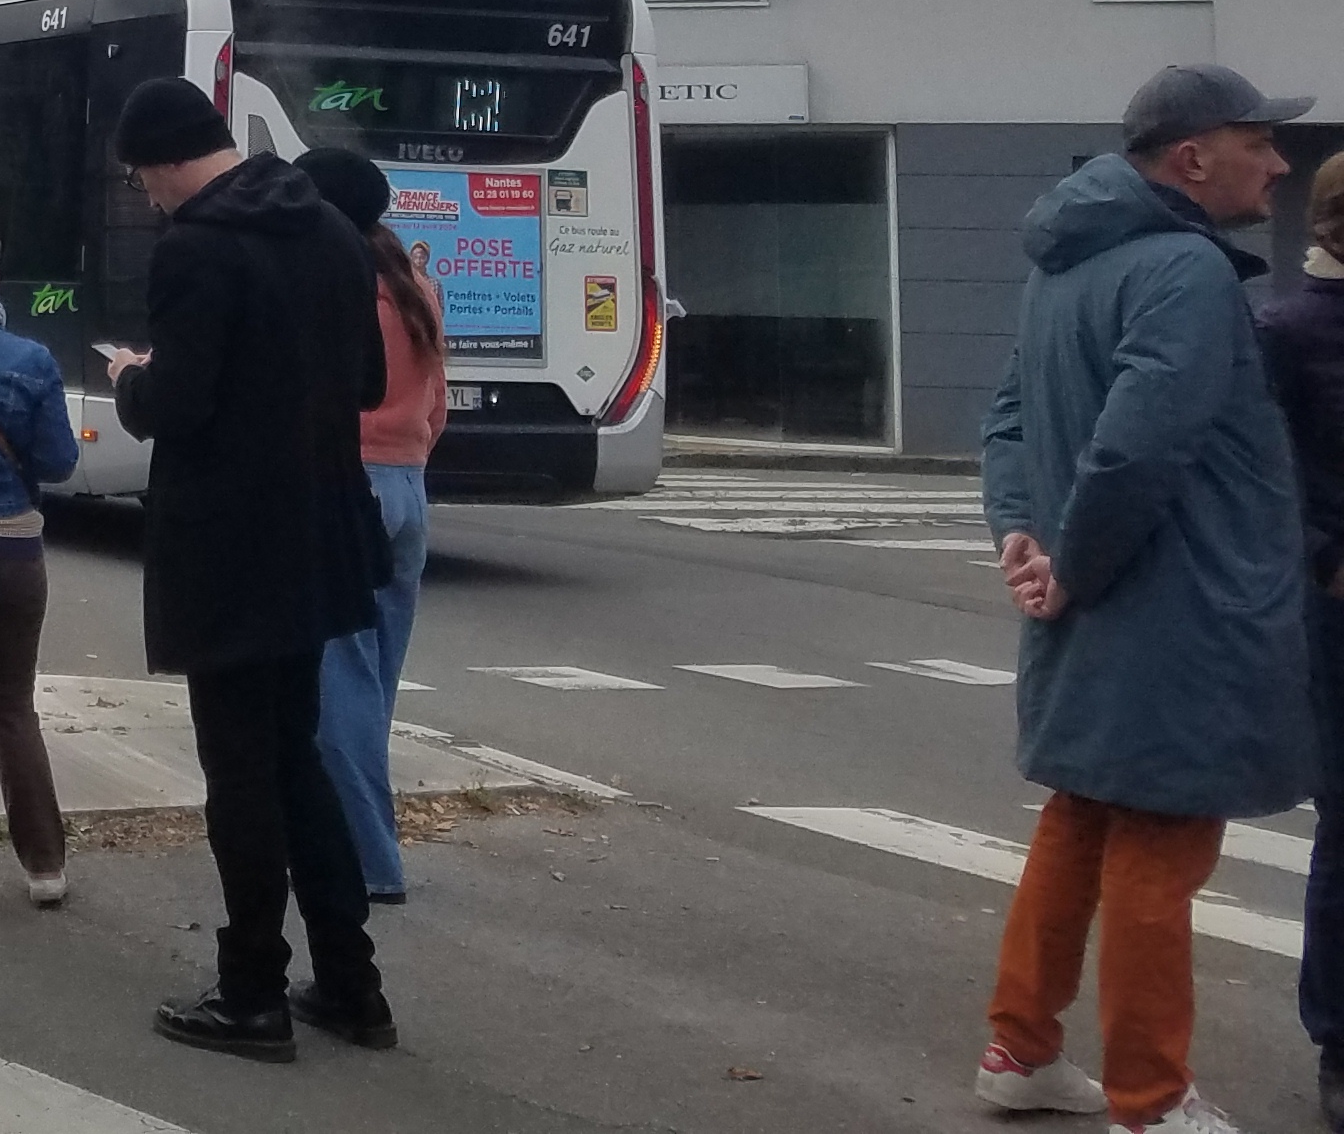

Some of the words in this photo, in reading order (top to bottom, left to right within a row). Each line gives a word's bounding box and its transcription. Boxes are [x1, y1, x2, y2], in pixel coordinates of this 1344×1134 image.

[41, 7, 68, 32] 641
[547, 24, 592, 48] 641
[309, 80, 388, 111] tan
[398, 143, 464, 161] IVECO
[485, 177, 522, 188] Nantes
[398, 191, 439, 202] FRANCE
[396, 200, 459, 212] MENUISIERS
[559, 226, 570, 235] Ce
[572, 225, 586, 235] bus
[457, 238, 513, 257] POSE
[549, 237, 575, 256] Gaz
[578, 240, 630, 256] naturel
[436, 258, 534, 279] OFFERTE
[31, 283, 79, 316] tan
[447, 290, 492, 302] Fenêtres
[503, 292, 536, 303] Volets
[449, 304, 483, 314] Portes
[494, 305, 534, 316] Portails
[448, 340, 457, 349] le
[459, 340, 478, 349] faire
